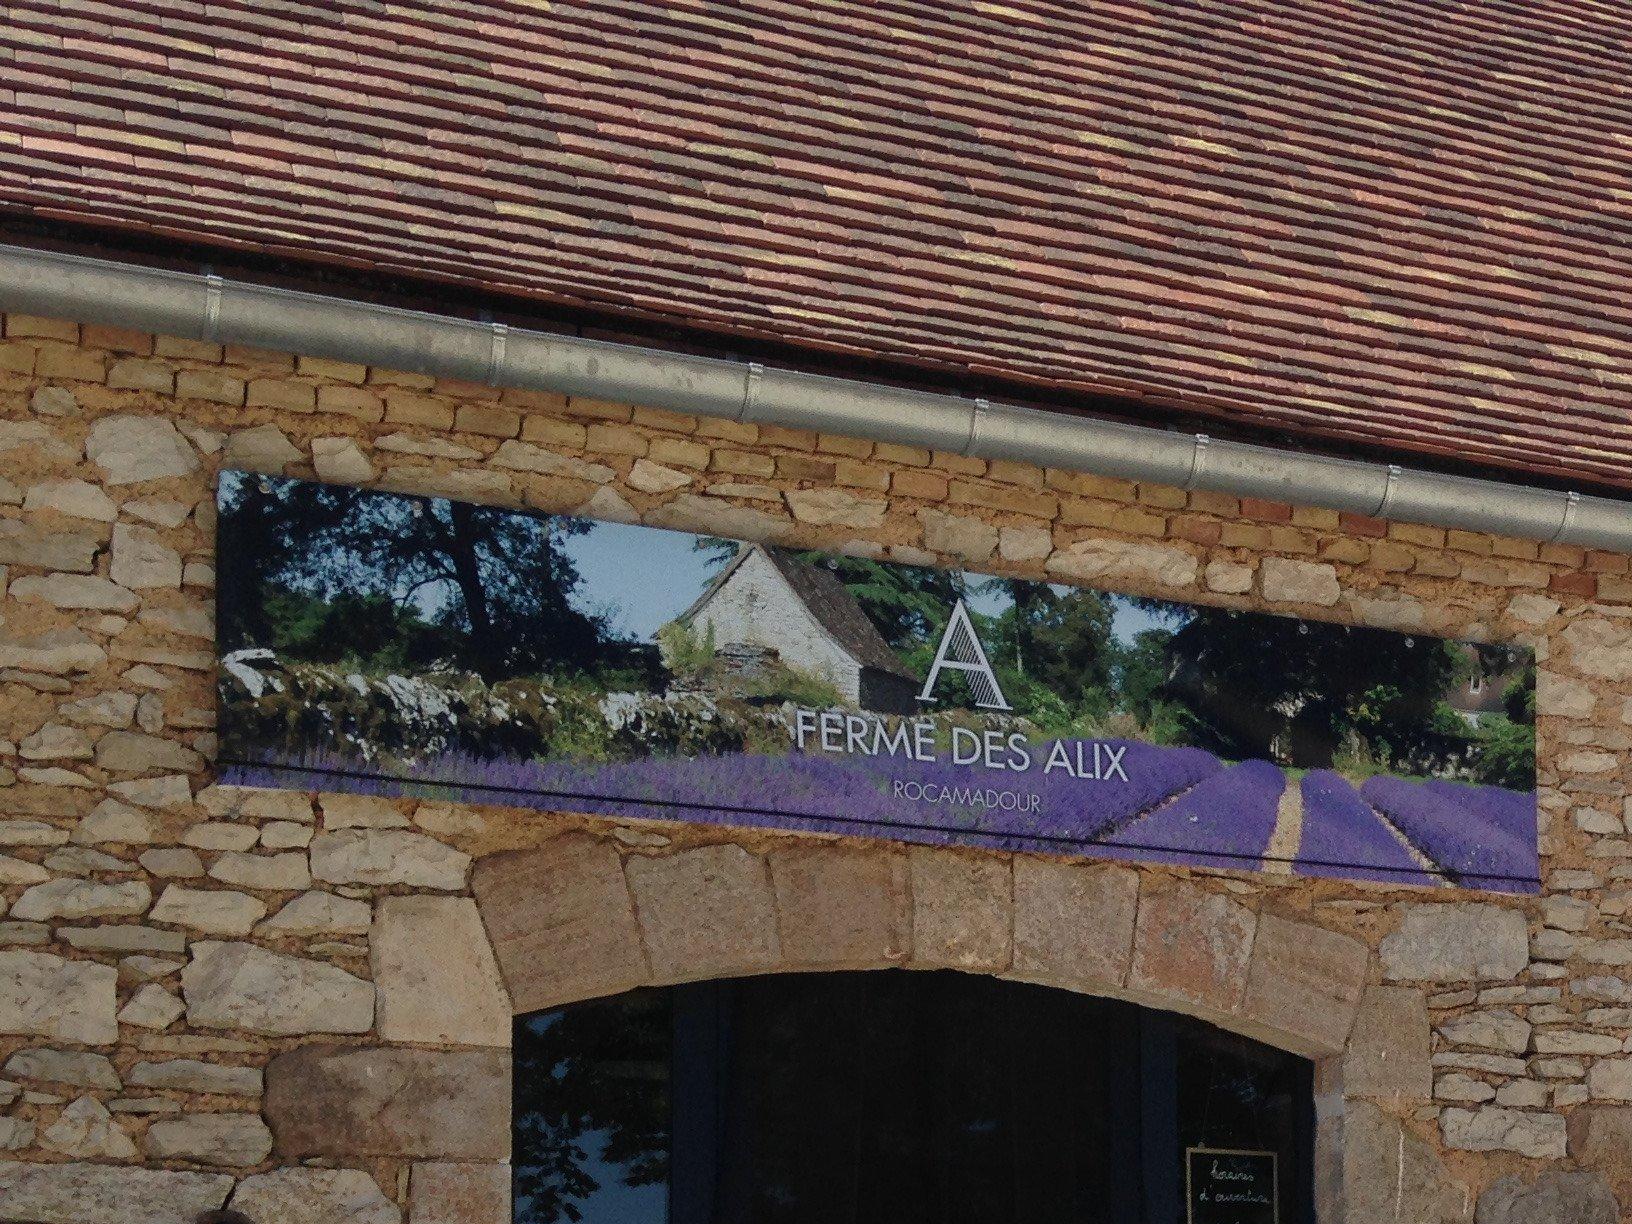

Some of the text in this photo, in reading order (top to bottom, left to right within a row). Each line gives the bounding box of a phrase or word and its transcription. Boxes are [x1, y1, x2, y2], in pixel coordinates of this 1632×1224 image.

[915, 598, 1013, 710] A
[796, 709, 1129, 782] FERME DES ALIX
[894, 779, 1041, 813] ROCAMADOUR
